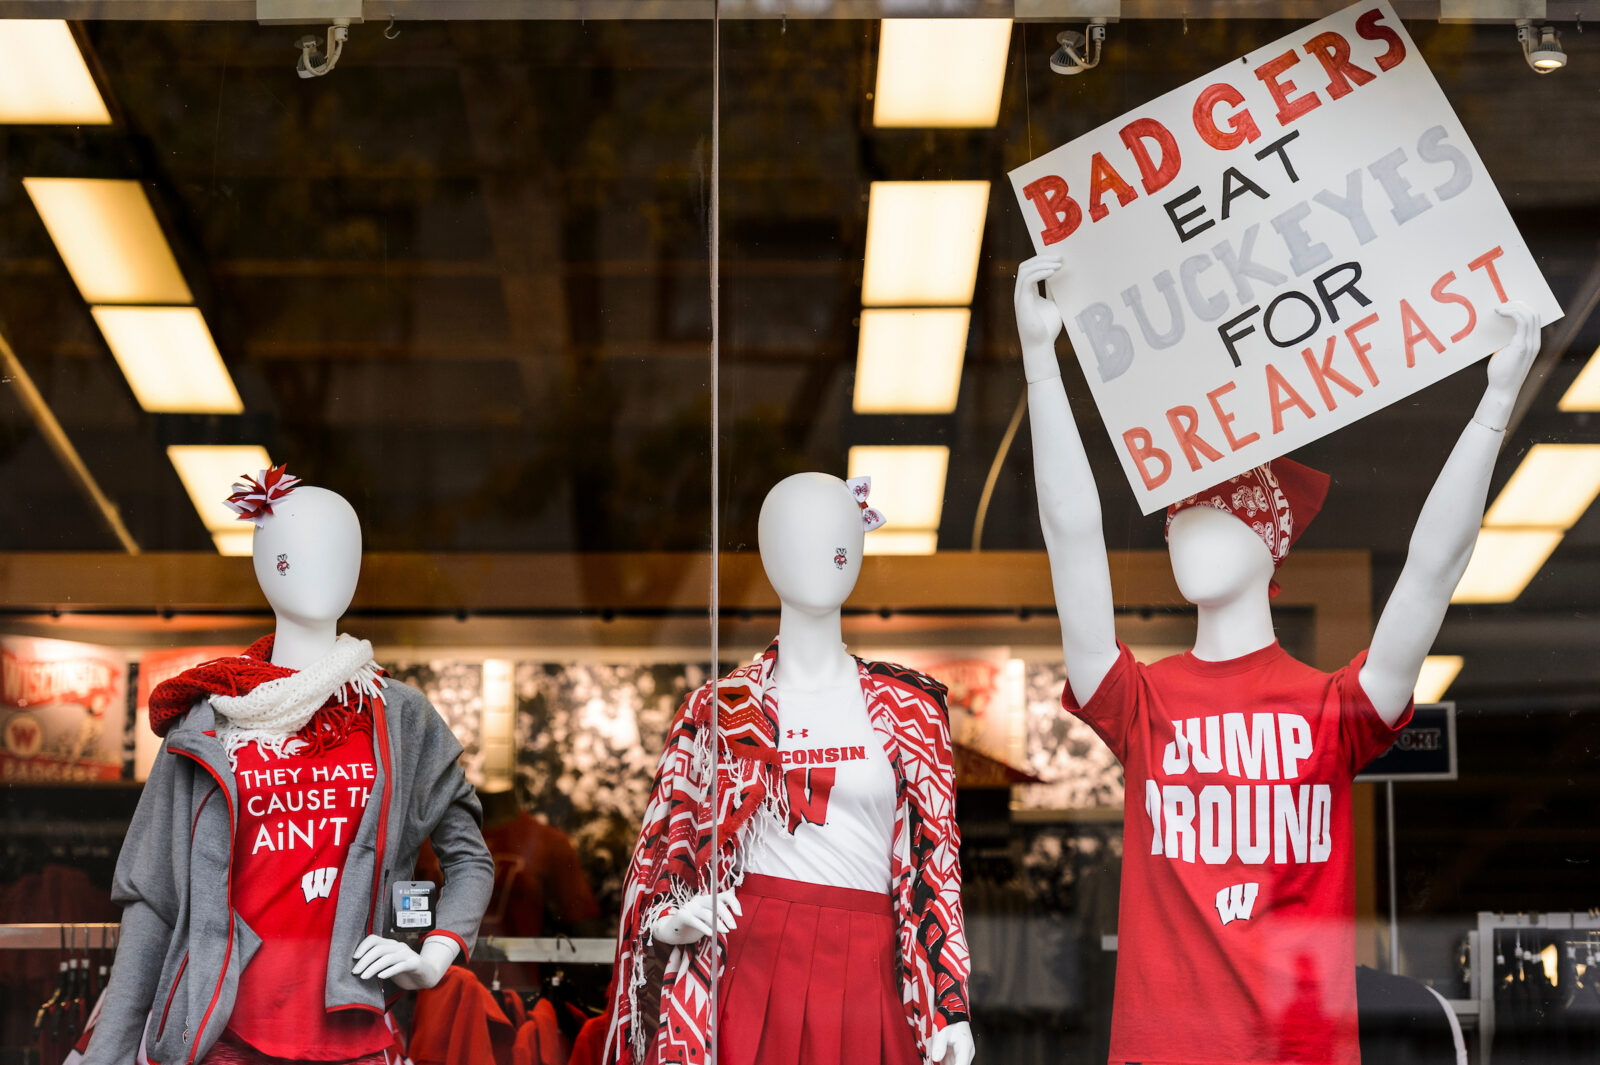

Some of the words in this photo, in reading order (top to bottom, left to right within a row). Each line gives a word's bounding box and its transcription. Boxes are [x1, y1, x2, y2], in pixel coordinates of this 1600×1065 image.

[1023, 8, 1407, 246] BADGERS
[1163, 129, 1300, 243] EAT
[1075, 125, 1473, 383] BUCKEYES
[1217, 261, 1372, 367] FOR
[1122, 245, 1509, 491] BREAKFAST
[240, 767, 302, 790] THEY
[311, 763, 375, 782] HATE
[778, 746, 866, 764] CONSIN
[1162, 712, 1314, 780] JUMP
[1396, 728, 1441, 751] ORT
[247, 788, 336, 817] CAUSE
